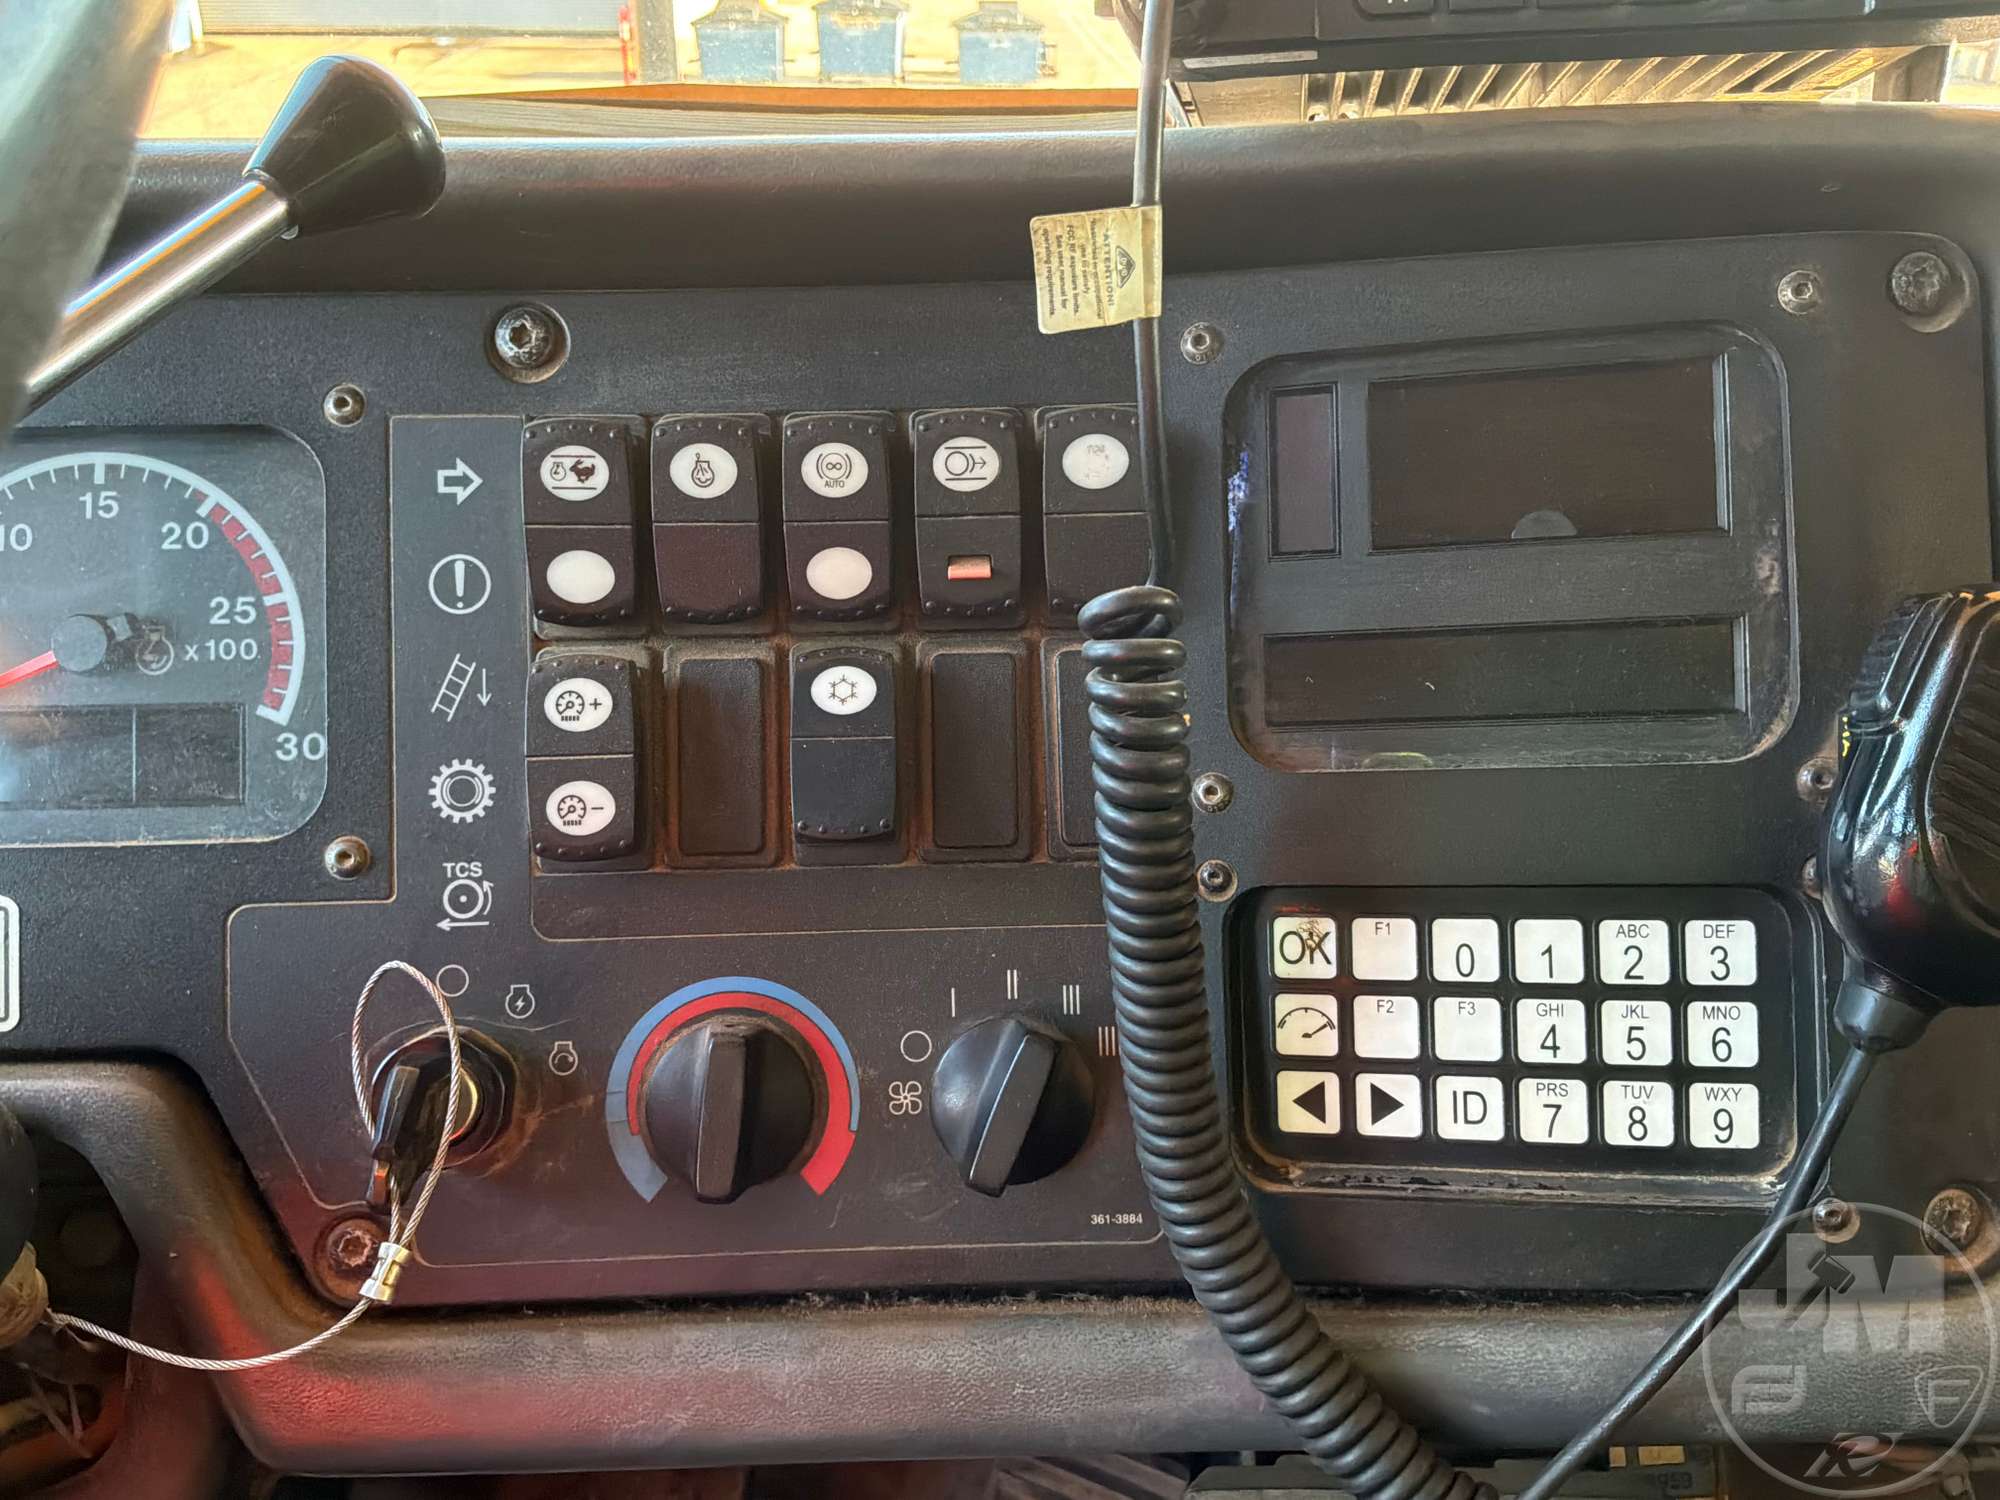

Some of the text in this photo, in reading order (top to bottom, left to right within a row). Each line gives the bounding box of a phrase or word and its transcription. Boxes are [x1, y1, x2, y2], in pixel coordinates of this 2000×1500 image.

[1043, 229, 1052, 264] operating
[1068, 243, 1075, 254] RF
[1059, 269, 1067, 297] manual
[1070, 256, 1078, 291] exposure
[824, 480, 845, 488] AUTO
[79, 491, 119, 519] 15
[161, 522, 209, 550] 20
[209, 596, 257, 625] 25
[275, 732, 327, 761] 30
[442, 861, 483, 878] TCS
[1375, 922, 1391, 936] F1
[1616, 924, 1650, 939] ABC
[1703, 924, 1736, 939] DEF
[1279, 930, 1332, 965] OK
[1456, 943, 1475, 978] 0
[1540, 944, 1553, 978] 1
[1623, 945, 1644, 980] 2
[1710, 946, 1730, 981] 3
[1376, 1000, 1394, 1013] F2
[1458, 1001, 1476, 1015] F3
[1536, 1003, 1564, 1017] GHI
[1621, 1005, 1649, 1019] JKL
[1702, 1006, 1741, 1020] MNO
[1540, 1024, 1560, 1058] 4
[1626, 1026, 1646, 1060] 5
[1712, 1027, 1732, 1062] 6
[1536, 1082, 1569, 1097] PRS
[1622, 1085, 1654, 1099] TUV
[1704, 1087, 1742, 1102] WXY
[1452, 1090, 1487, 1125] ID
[1543, 1104, 1562, 1138] 7
[1628, 1106, 1648, 1141] 8
[1713, 1108, 1733, 1143] 9
[1090, 1213, 1143, 1225] 361-3884
